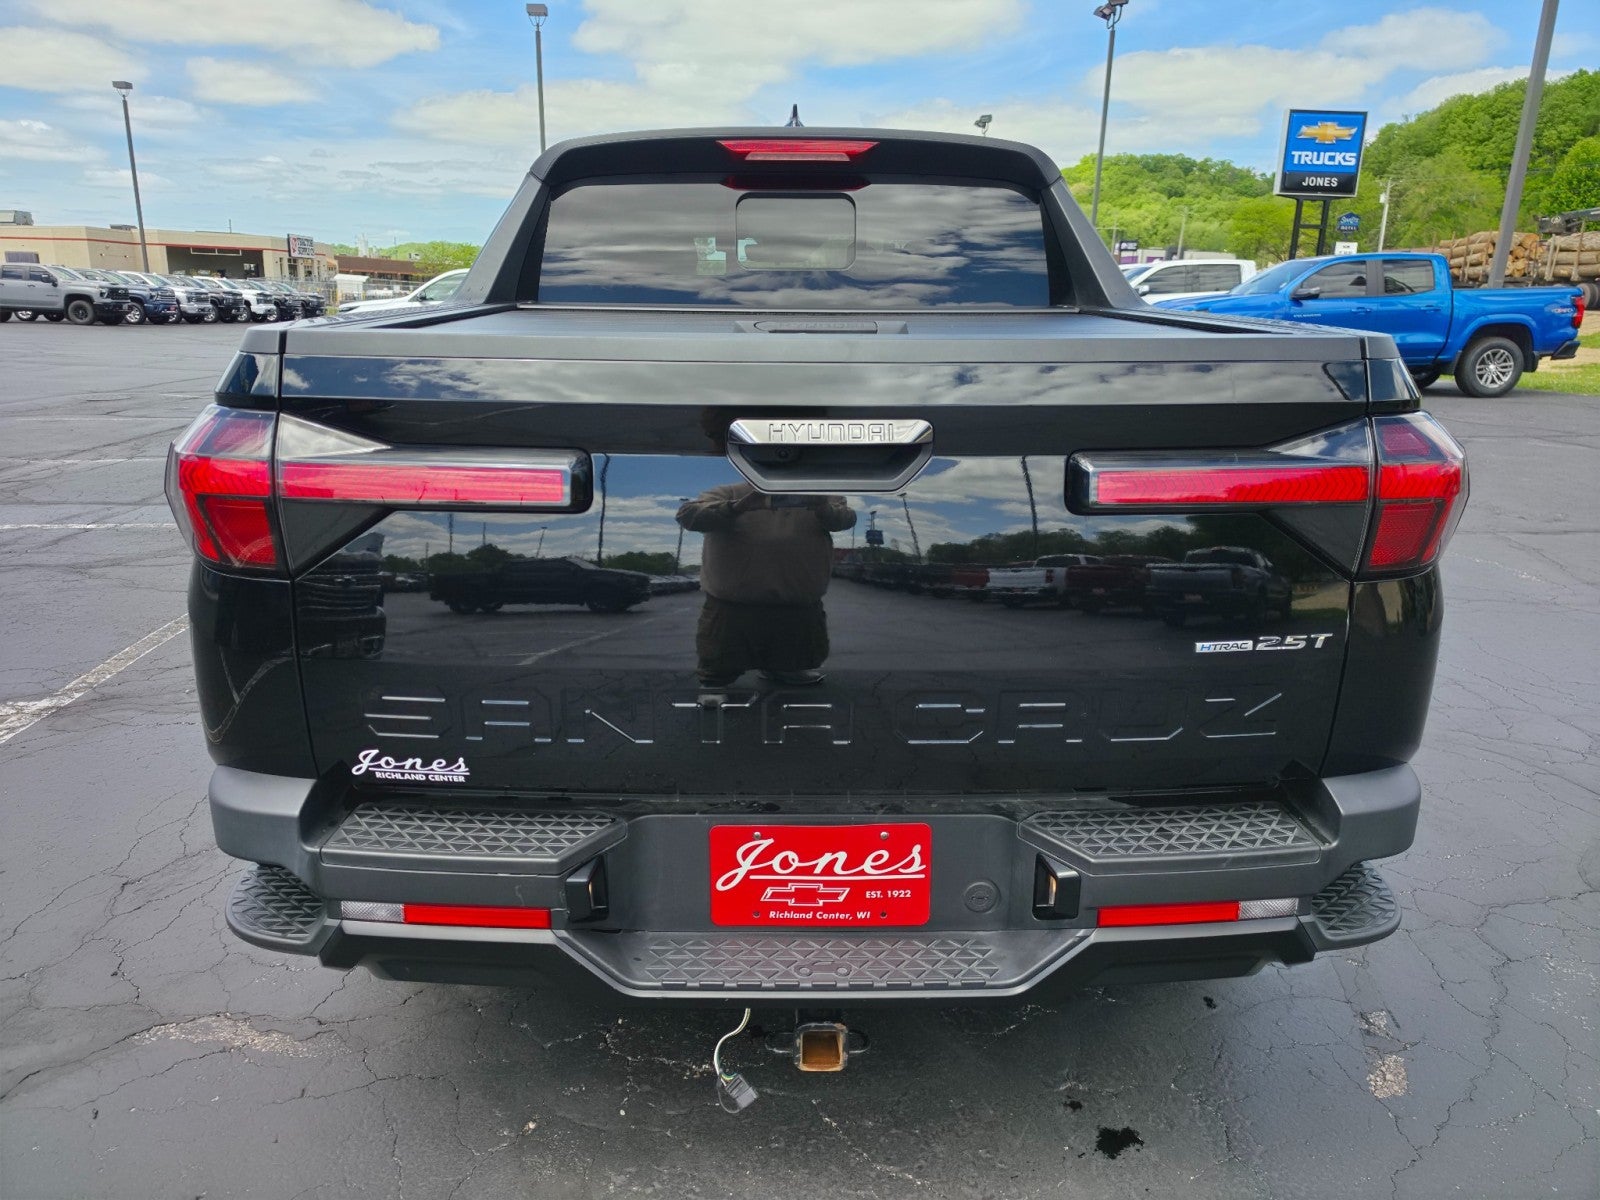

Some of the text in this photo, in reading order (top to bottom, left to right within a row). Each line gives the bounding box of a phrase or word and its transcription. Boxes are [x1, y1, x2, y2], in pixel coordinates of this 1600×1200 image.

[1291, 151, 1356, 166] TRUCKS
[1302, 177, 1338, 187] JONES
[768, 423, 894, 442] HYUNDAI
[1200, 642, 1249, 652] HTRAC
[363, 686, 1285, 744] SANTA CRUZ
[351, 749, 469, 775] Jones
[375, 771, 466, 783] RICHLAND CENTER
[715, 838, 927, 892] Jones
[865, 889, 911, 899] EST. 1922
[769, 910, 871, 921] Richland Center, WI
